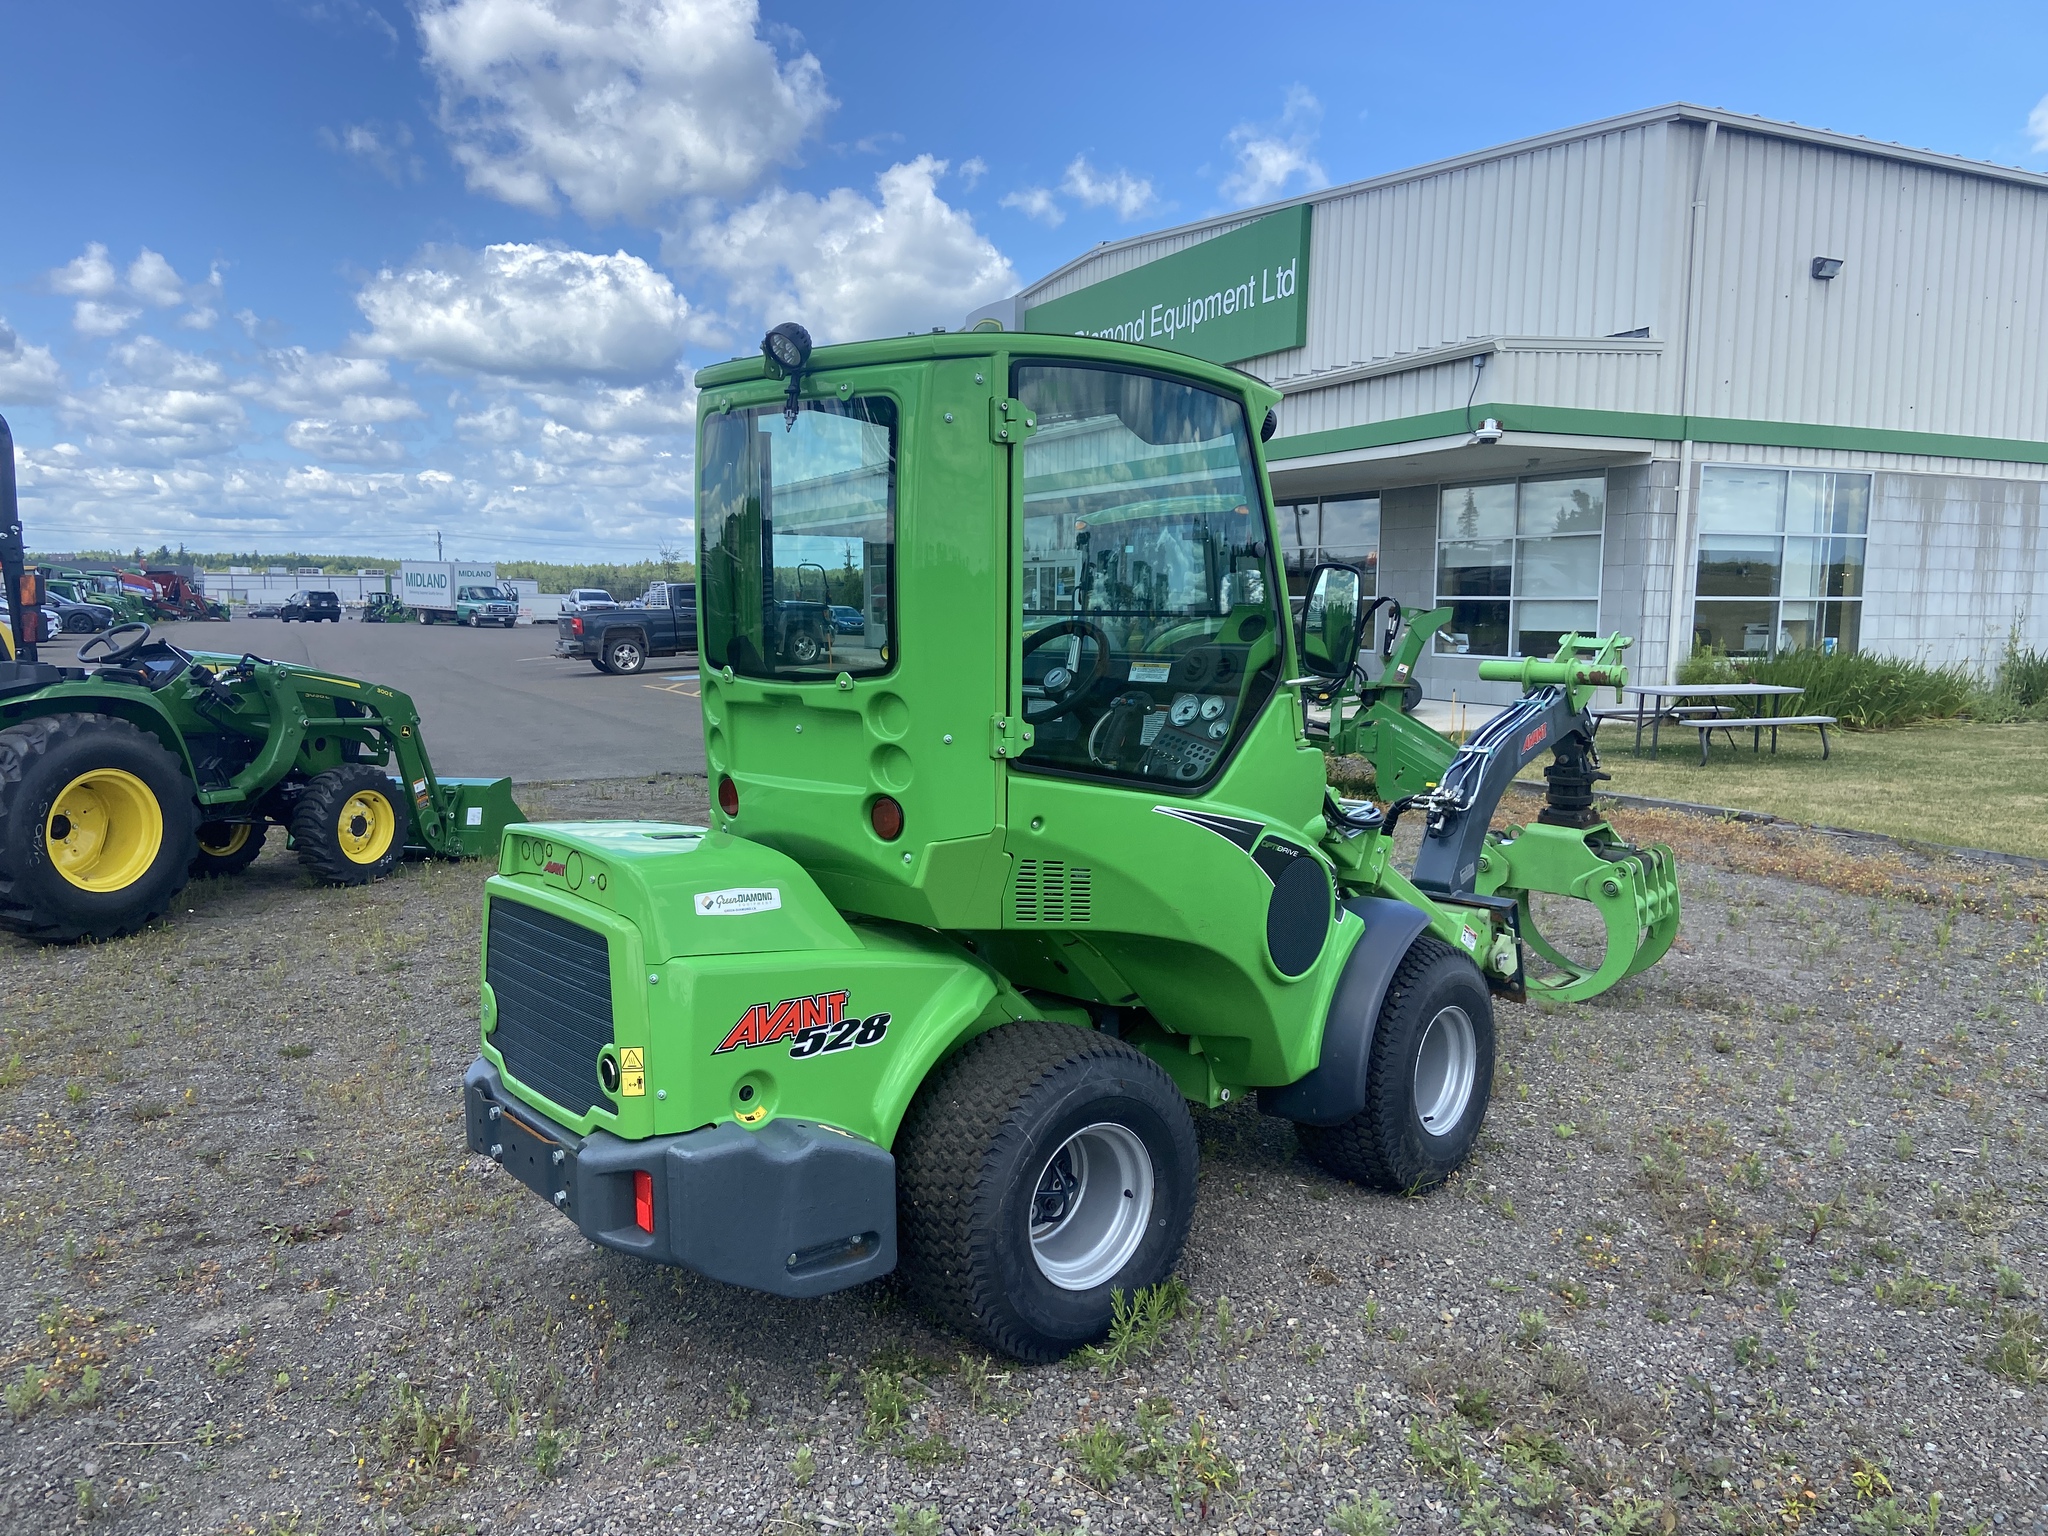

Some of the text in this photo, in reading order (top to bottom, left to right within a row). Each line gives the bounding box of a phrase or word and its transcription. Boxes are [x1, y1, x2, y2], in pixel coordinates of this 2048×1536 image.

[1074, 257, 1296, 342] mond Equipment Ltd
[405, 572, 447, 589] MIDLAND
[458, 570, 492, 578] MIDLAND
[1521, 721, 1547, 756] AVANT
[543, 861, 566, 877] AVANT
[710, 989, 892, 1060] AVANT 528
